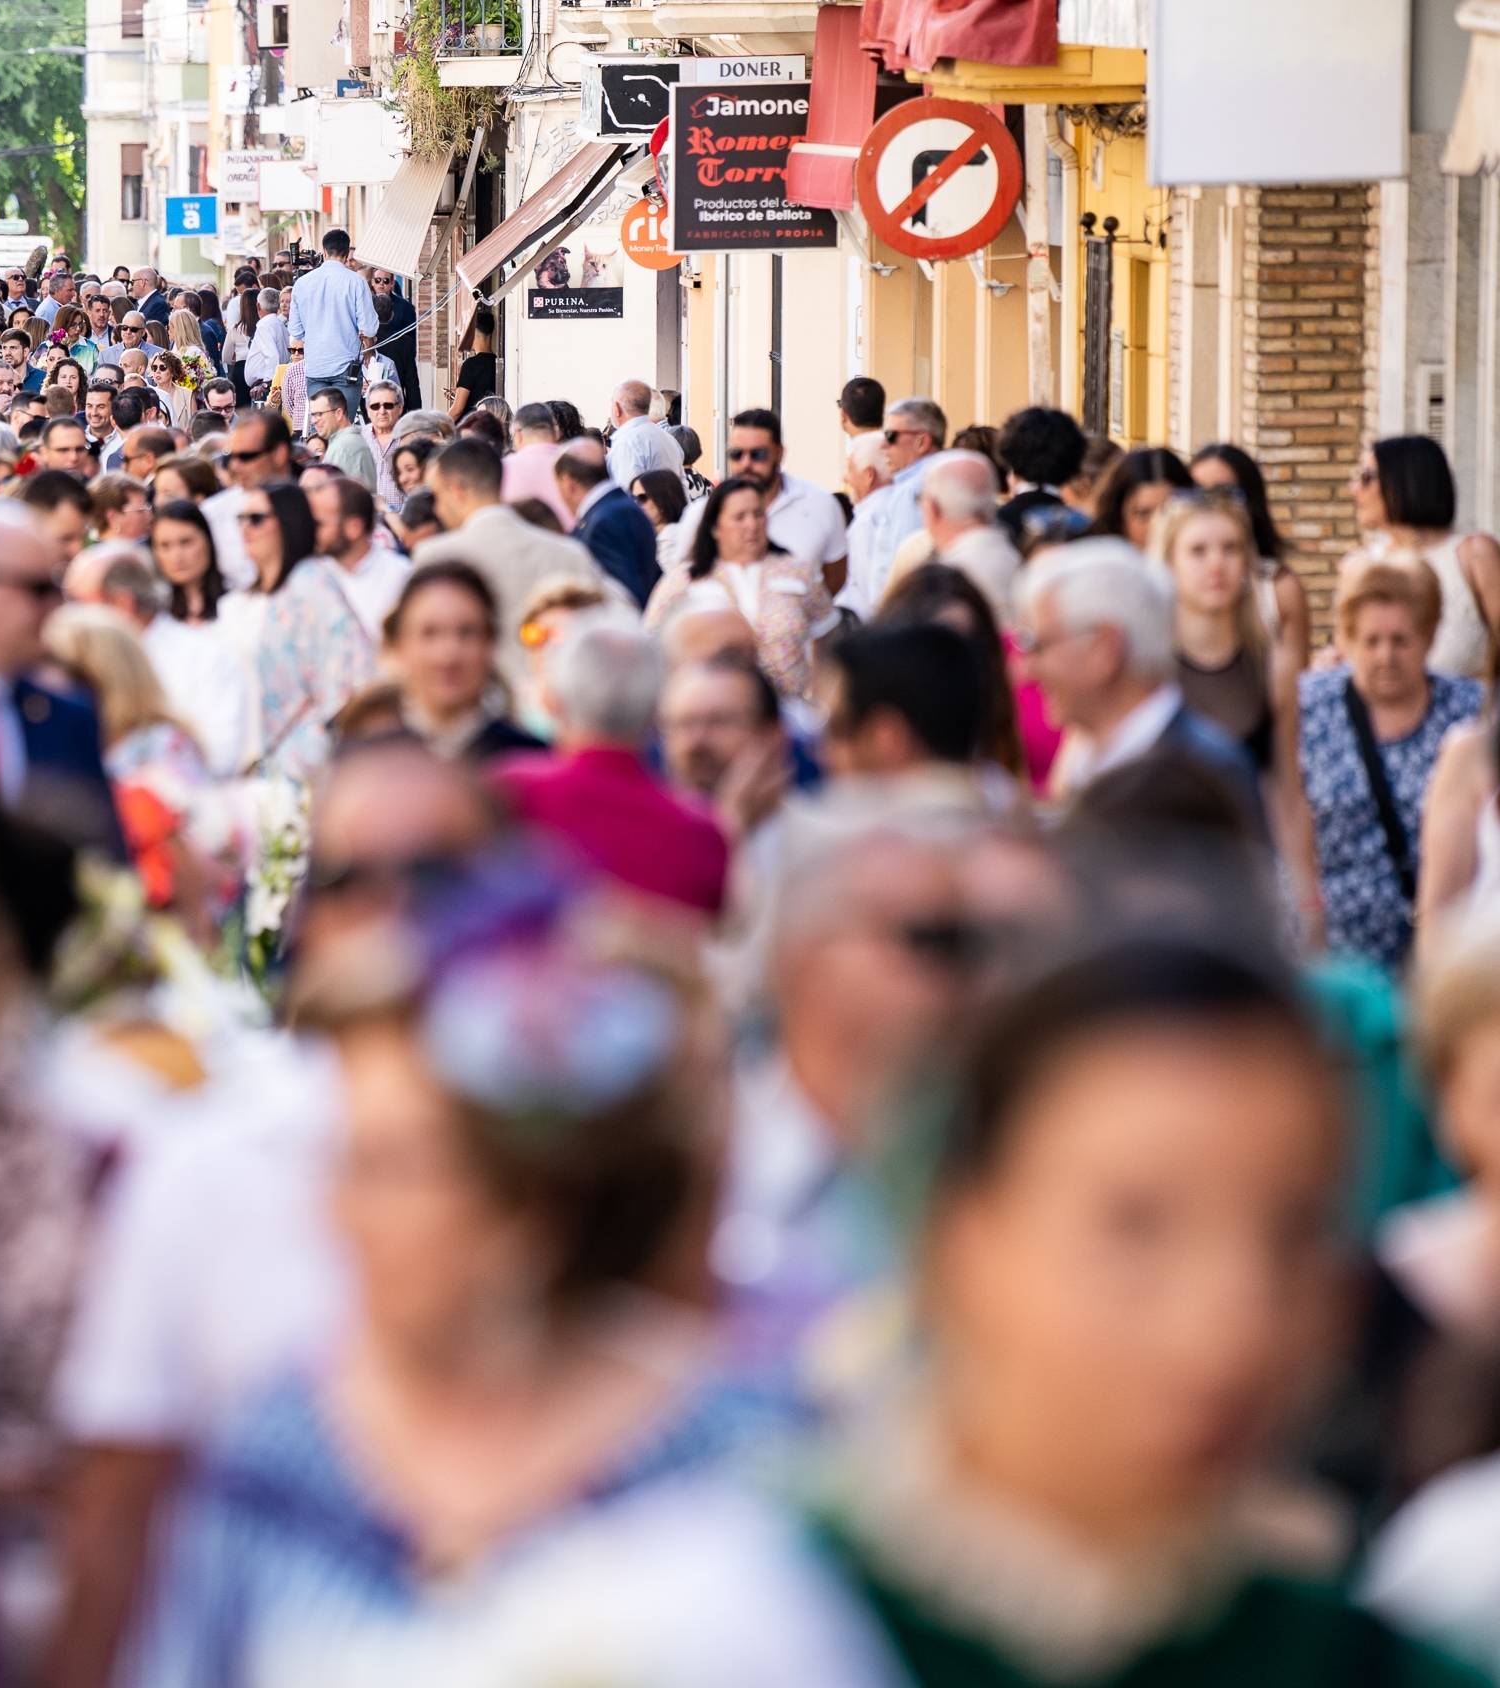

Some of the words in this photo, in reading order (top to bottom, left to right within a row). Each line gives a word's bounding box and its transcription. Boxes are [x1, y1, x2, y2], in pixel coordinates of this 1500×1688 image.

[720, 61, 782, 78] DONER
[705, 96, 809, 117] Jamone
[694, 198, 758, 210] Productos
[759, 197, 779, 208] del
[699, 210, 744, 222] Ibérico
[746, 210, 764, 221] de
[766, 210, 812, 221] Bellota
[686, 229, 770, 239] FABRICACIÓN
[776, 229, 825, 238] PROPIA
[629, 245, 654, 253] Money
